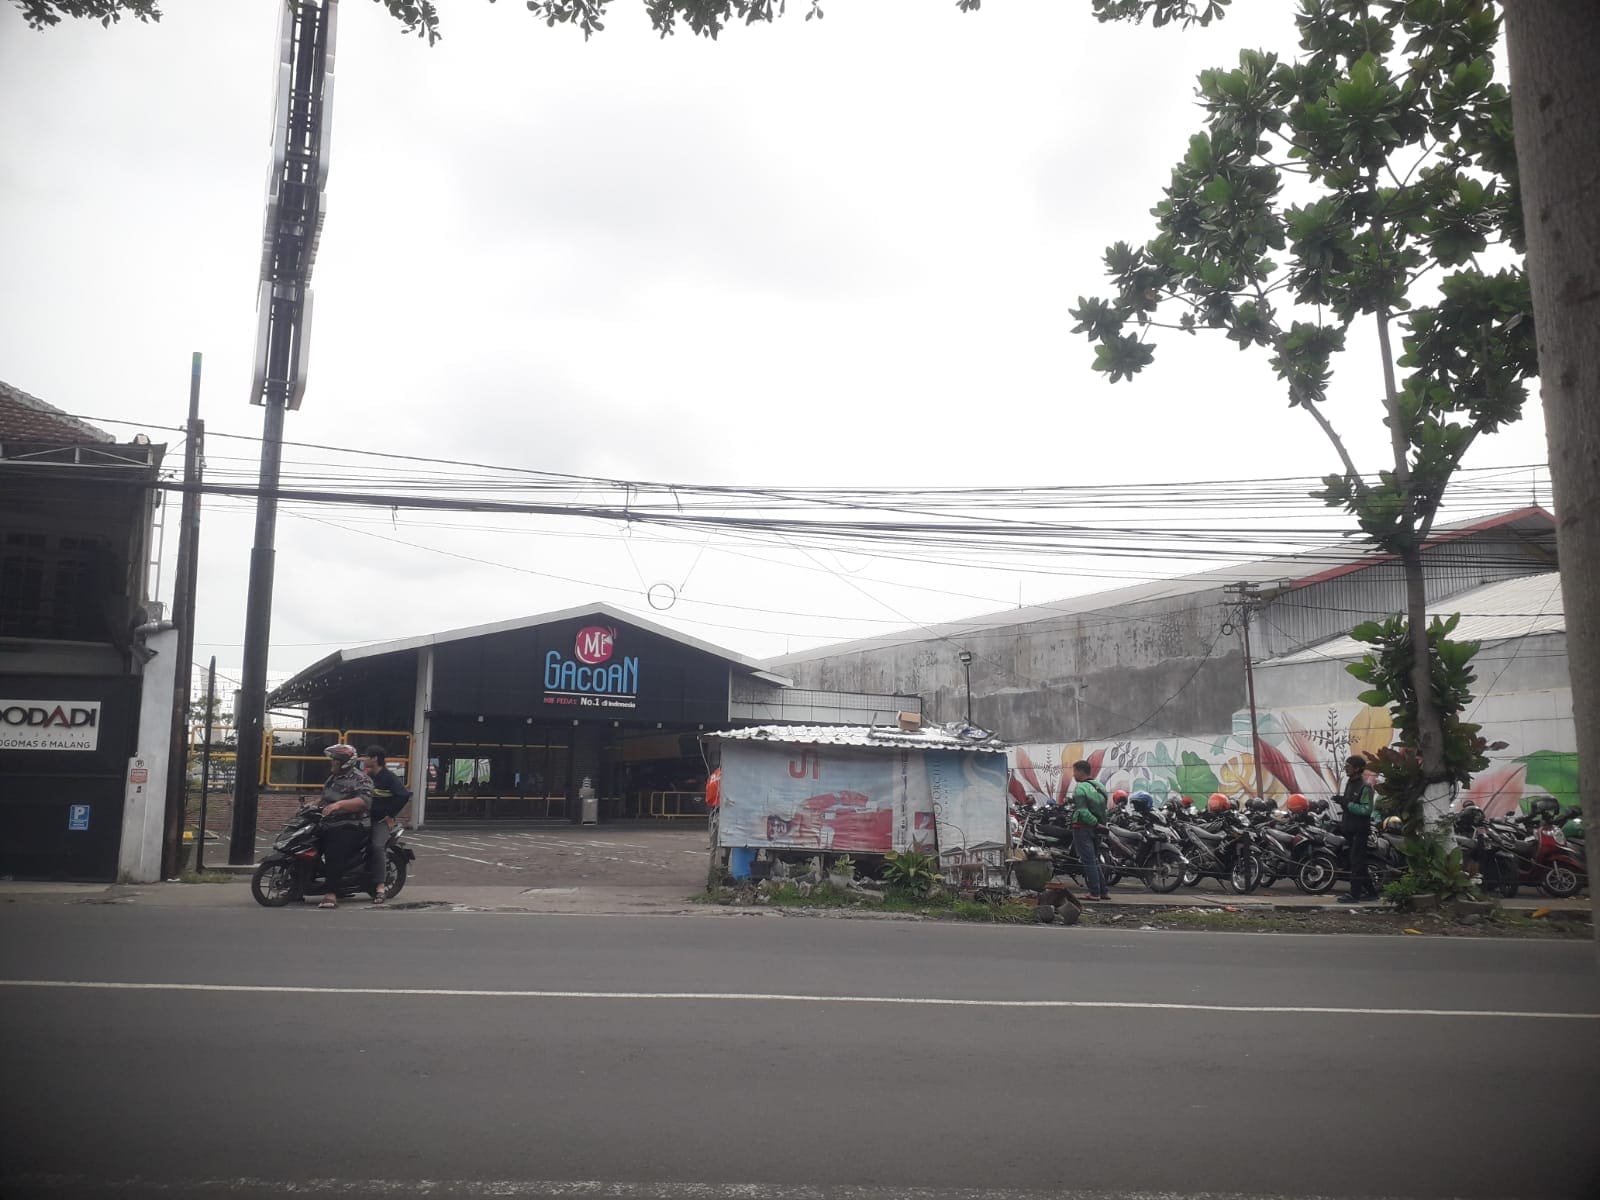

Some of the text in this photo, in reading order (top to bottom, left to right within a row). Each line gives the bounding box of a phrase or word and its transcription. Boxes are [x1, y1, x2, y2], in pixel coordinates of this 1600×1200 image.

[545, 650, 639, 694] GACOAN
[580, 696, 600, 707] No.1
[0, 705, 97, 729] ODADI
[49, 741, 91, 749] MALANG
